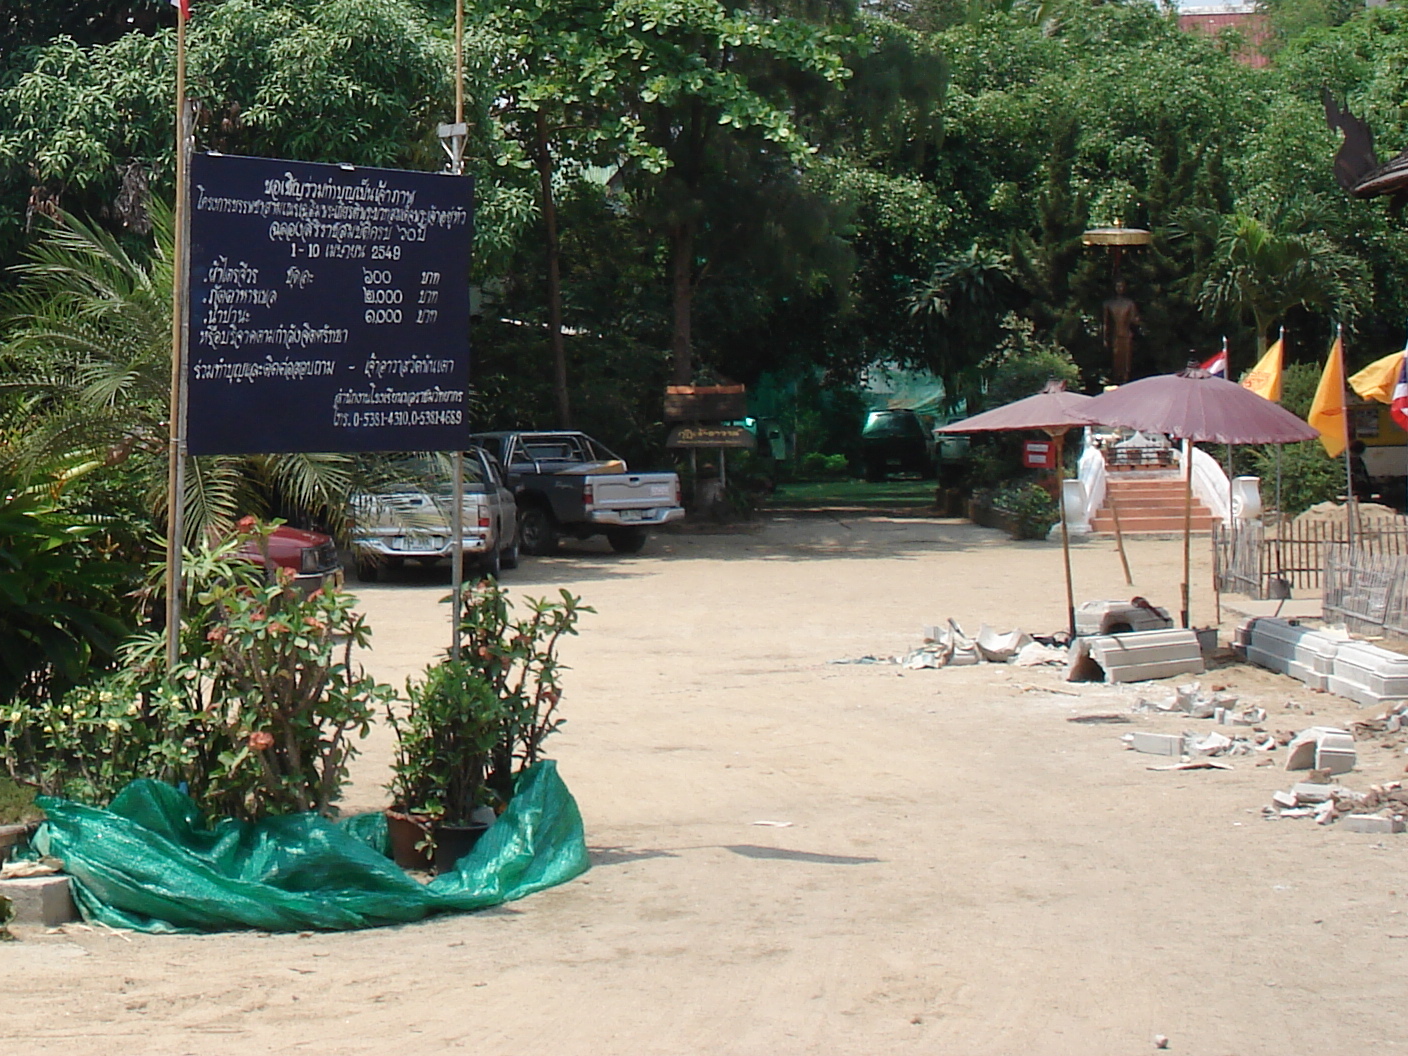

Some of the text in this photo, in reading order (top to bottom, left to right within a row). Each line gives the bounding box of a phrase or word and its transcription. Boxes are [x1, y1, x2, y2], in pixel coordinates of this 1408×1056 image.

[264, 171, 417, 206] ขอเชิญร่วมทำบุญเป็นเจ้าภาพ
[325, 244, 367, 259] เมษายน
[371, 245, 401, 261] 2549
[285, 266, 315, 289] ชุดละ
[363, 267, 392, 285] ๖๐๐
[421, 271, 441, 286] บาท
[418, 290, 439, 305] บาท
[416, 310, 438, 324] บาท
[193, 355, 335, 383] ร่วมทำบุญและติดต่อสอบถาม
